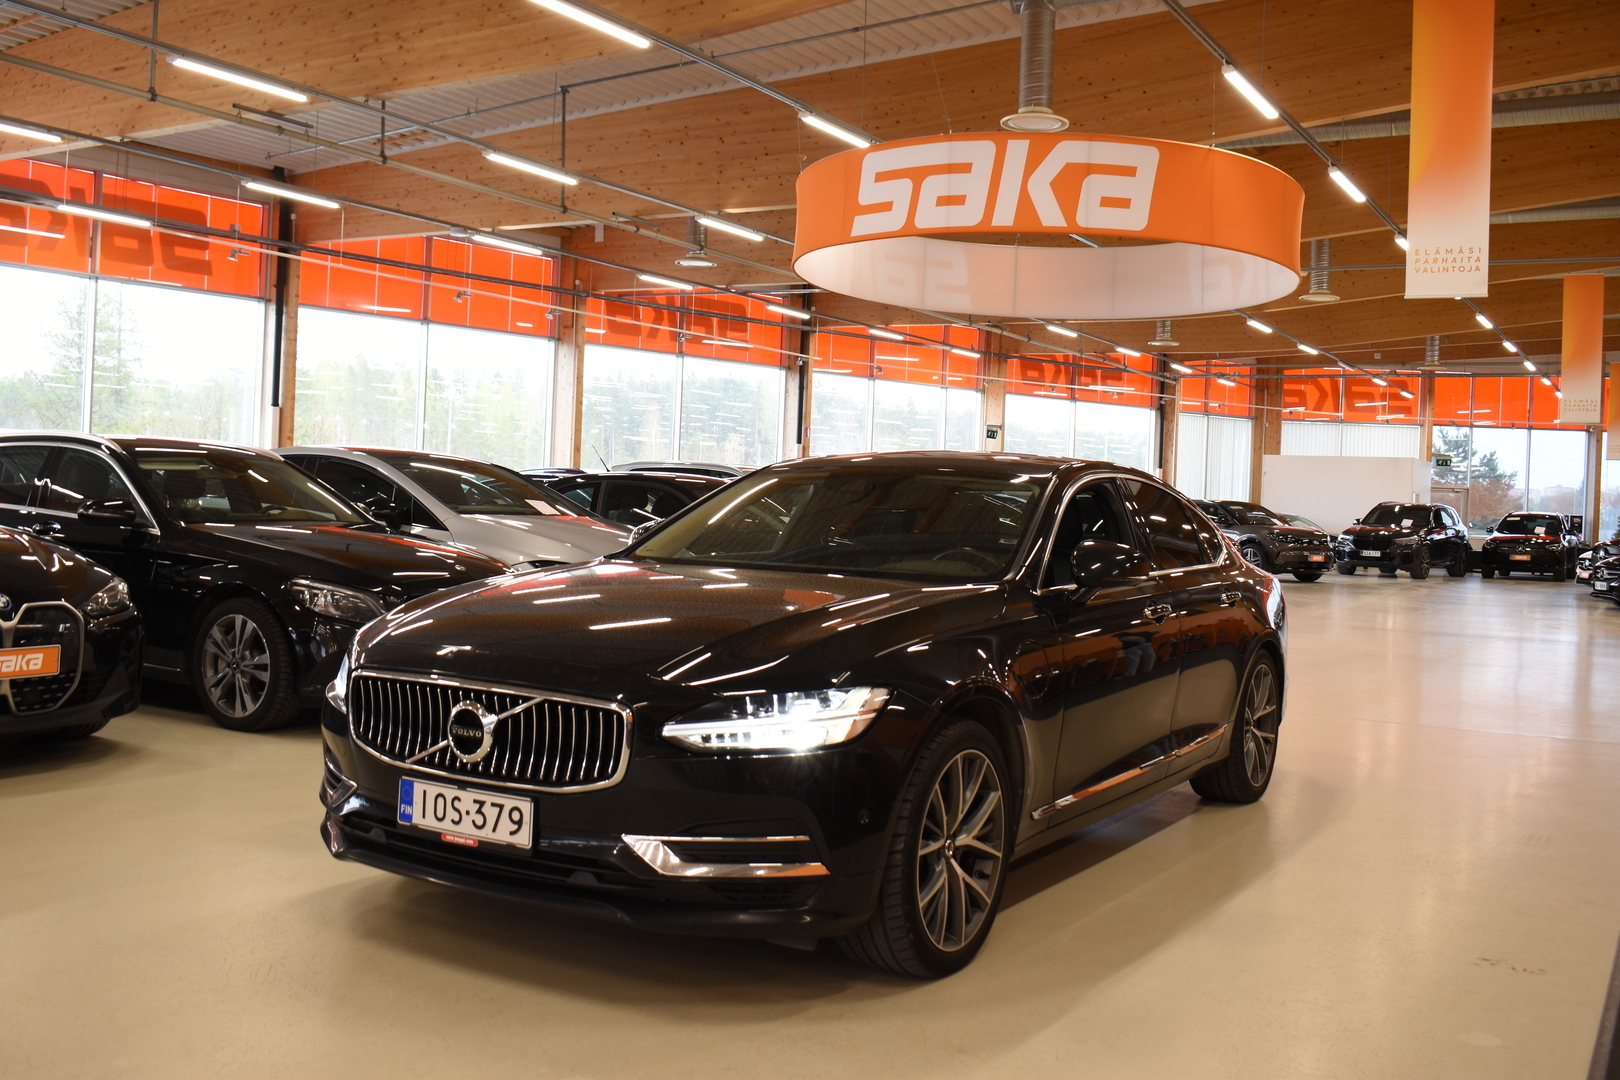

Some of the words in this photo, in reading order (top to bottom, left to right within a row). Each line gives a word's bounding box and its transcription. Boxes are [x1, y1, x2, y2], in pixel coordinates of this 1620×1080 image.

[1414, 246, 1482, 256] ELÄMÄSI
[1414, 256, 1482, 265] PARHAITA
[1414, 265, 1481, 274] VALINTOJA
[0, 652, 44, 673] aka
[452, 726, 482, 738] VOLVO
[400, 803, 413, 815] FIN
[422, 789, 524, 836] IOS-379
